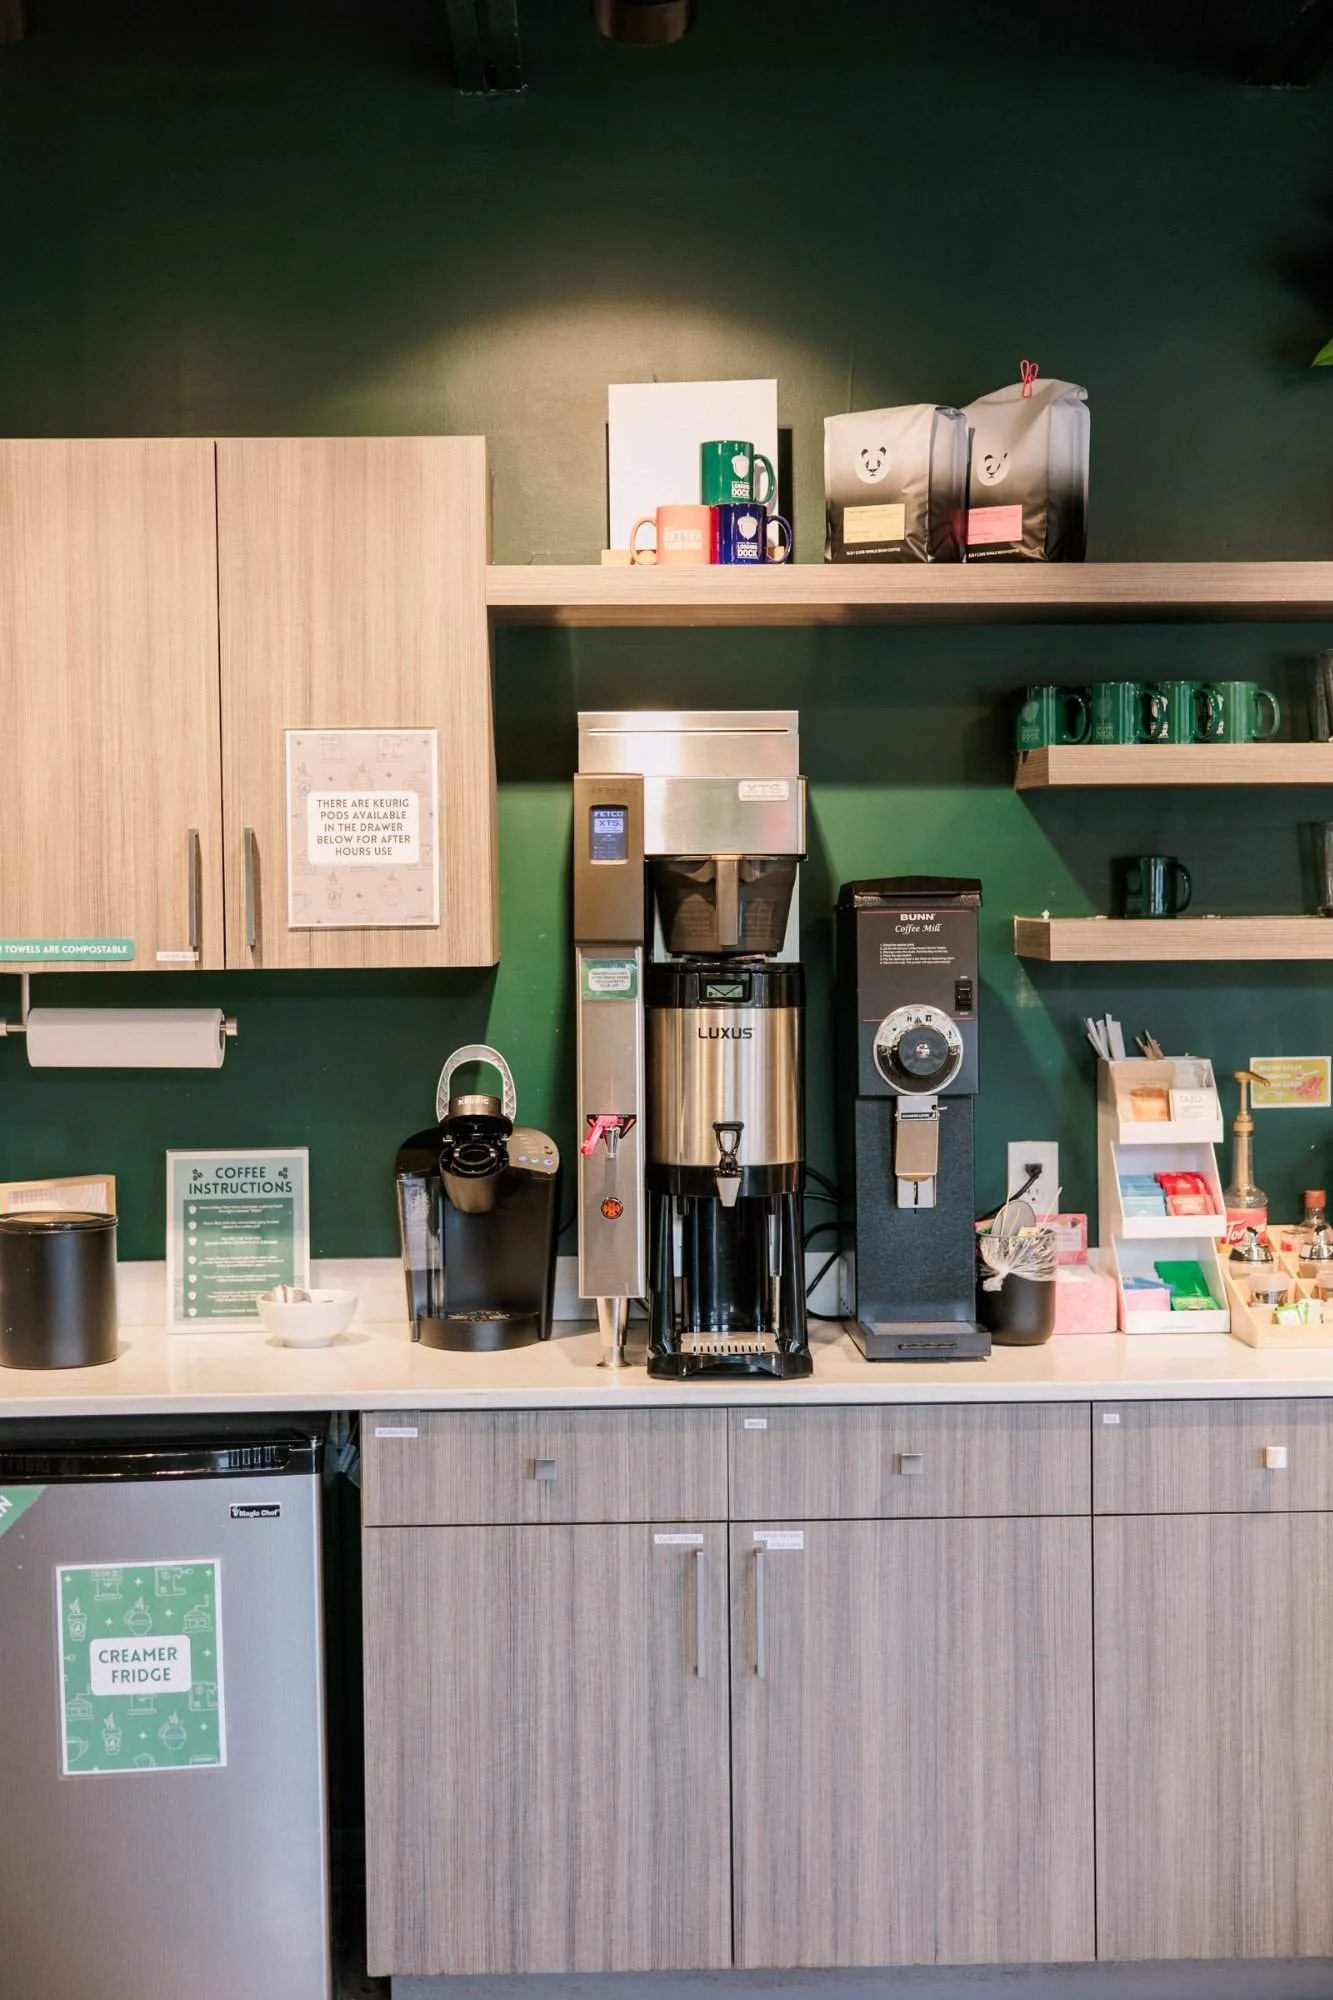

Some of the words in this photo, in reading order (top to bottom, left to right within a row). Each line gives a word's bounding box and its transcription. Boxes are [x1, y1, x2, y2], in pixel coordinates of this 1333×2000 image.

[737, 550, 758, 558] DOCK
[317, 799, 348, 808] THERE
[351, 799, 369, 808] ARE
[373, 799, 409, 807] KEURIG
[320, 811, 349, 820] PODS
[352, 811, 406, 820] AVAILABLE
[324, 823, 335, 832] IN
[338, 823, 356, 832] THE
[360, 823, 403, 832] DRAWER
[316, 835, 353, 844] BELOW
[356, 835, 377, 844] FOR
[380, 835, 410, 844] AFTER
[335, 847, 371, 856] HOURS
[374, 847, 393, 855] USE
[895, 924, 920, 935] Coffee
[922, 923, 943, 933] Mill
[4, 945, 40, 953] TOWELS
[43, 945, 59, 953] ARE
[62, 945, 128, 954] COMPOSTABLE
[698, 1027, 753, 1039] LUXUS
[215, 1166, 267, 1179] COFFEE
[188, 1181, 293, 1195] INSTRUCTIONS
[98, 1647, 178, 1664] CREAMER
[111, 1667, 171, 1684] FRIDGE
